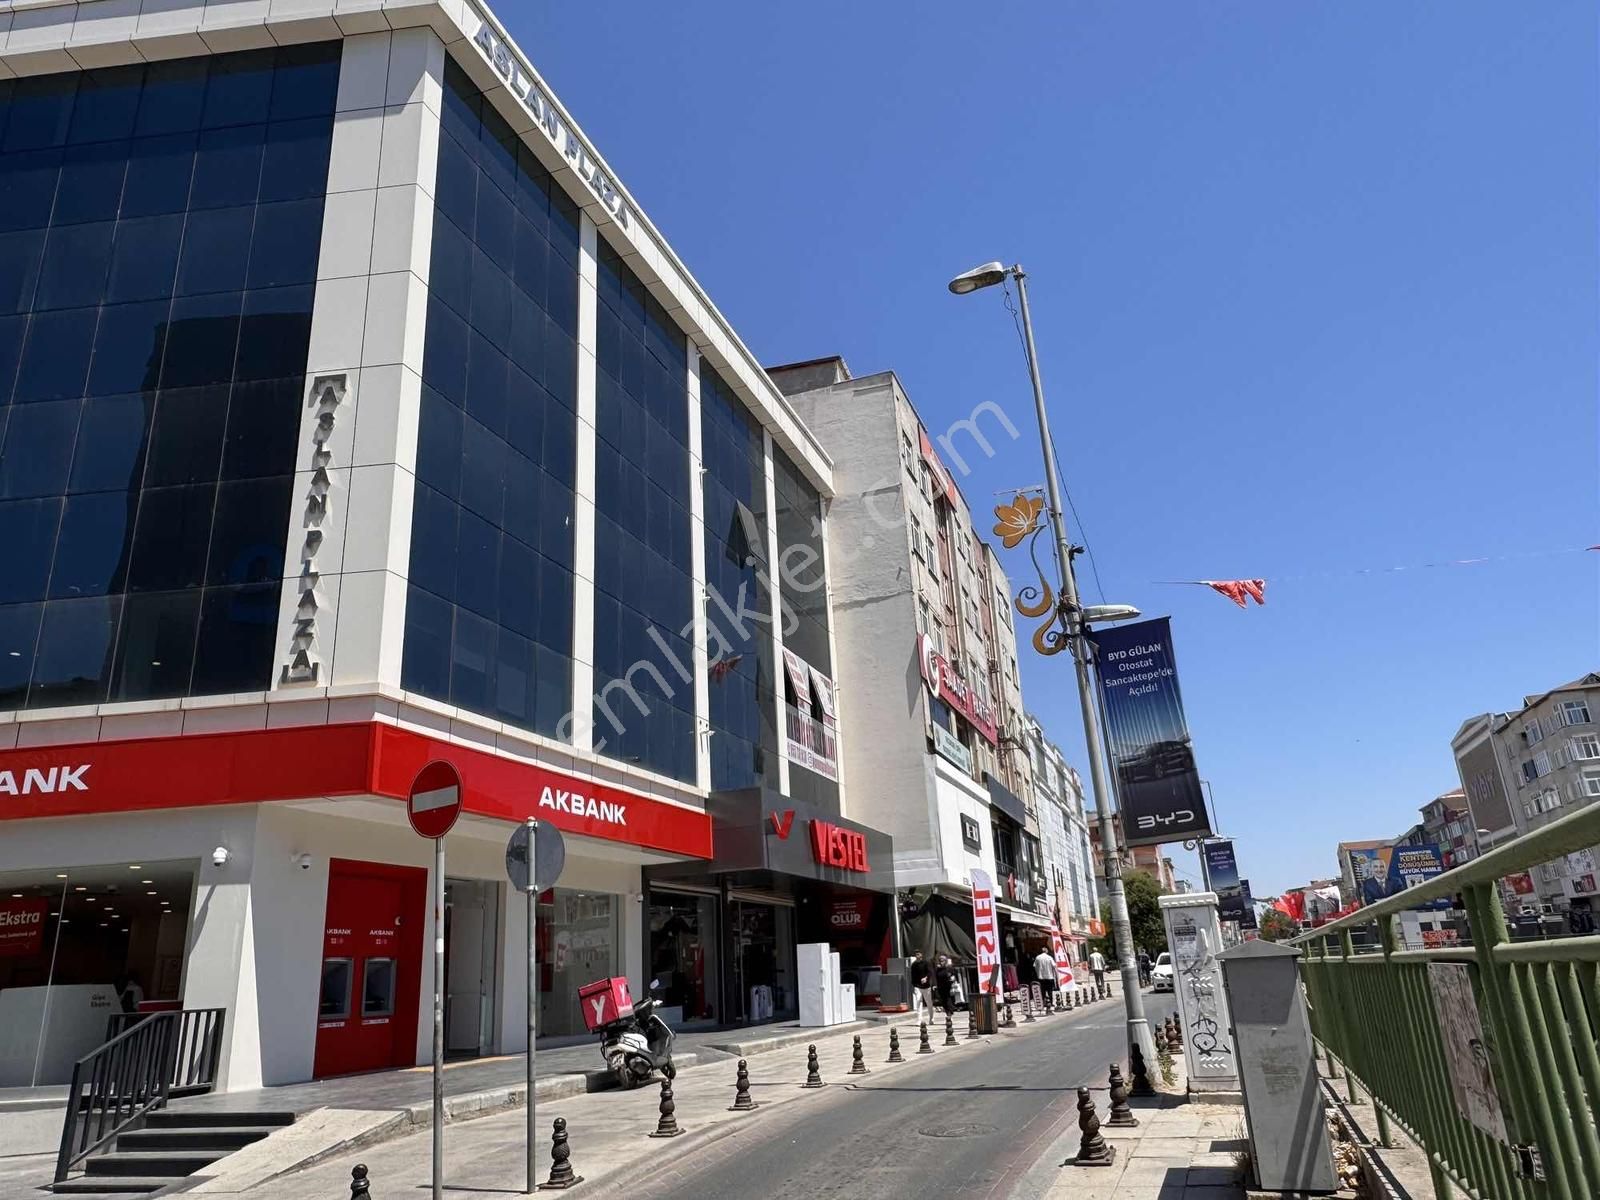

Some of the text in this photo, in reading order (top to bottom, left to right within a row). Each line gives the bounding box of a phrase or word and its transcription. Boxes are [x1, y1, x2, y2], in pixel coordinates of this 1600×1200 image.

[473, 20, 630, 231] ASLAN PLAZA
[1107, 643, 1161, 661] BYD GÜLAN
[1105, 667, 1173, 687] Sancaktepe'de
[538, 786, 627, 826] AKBANK
[1137, 809, 1195, 829] BYD
[808, 818, 871, 873] VESTEL
